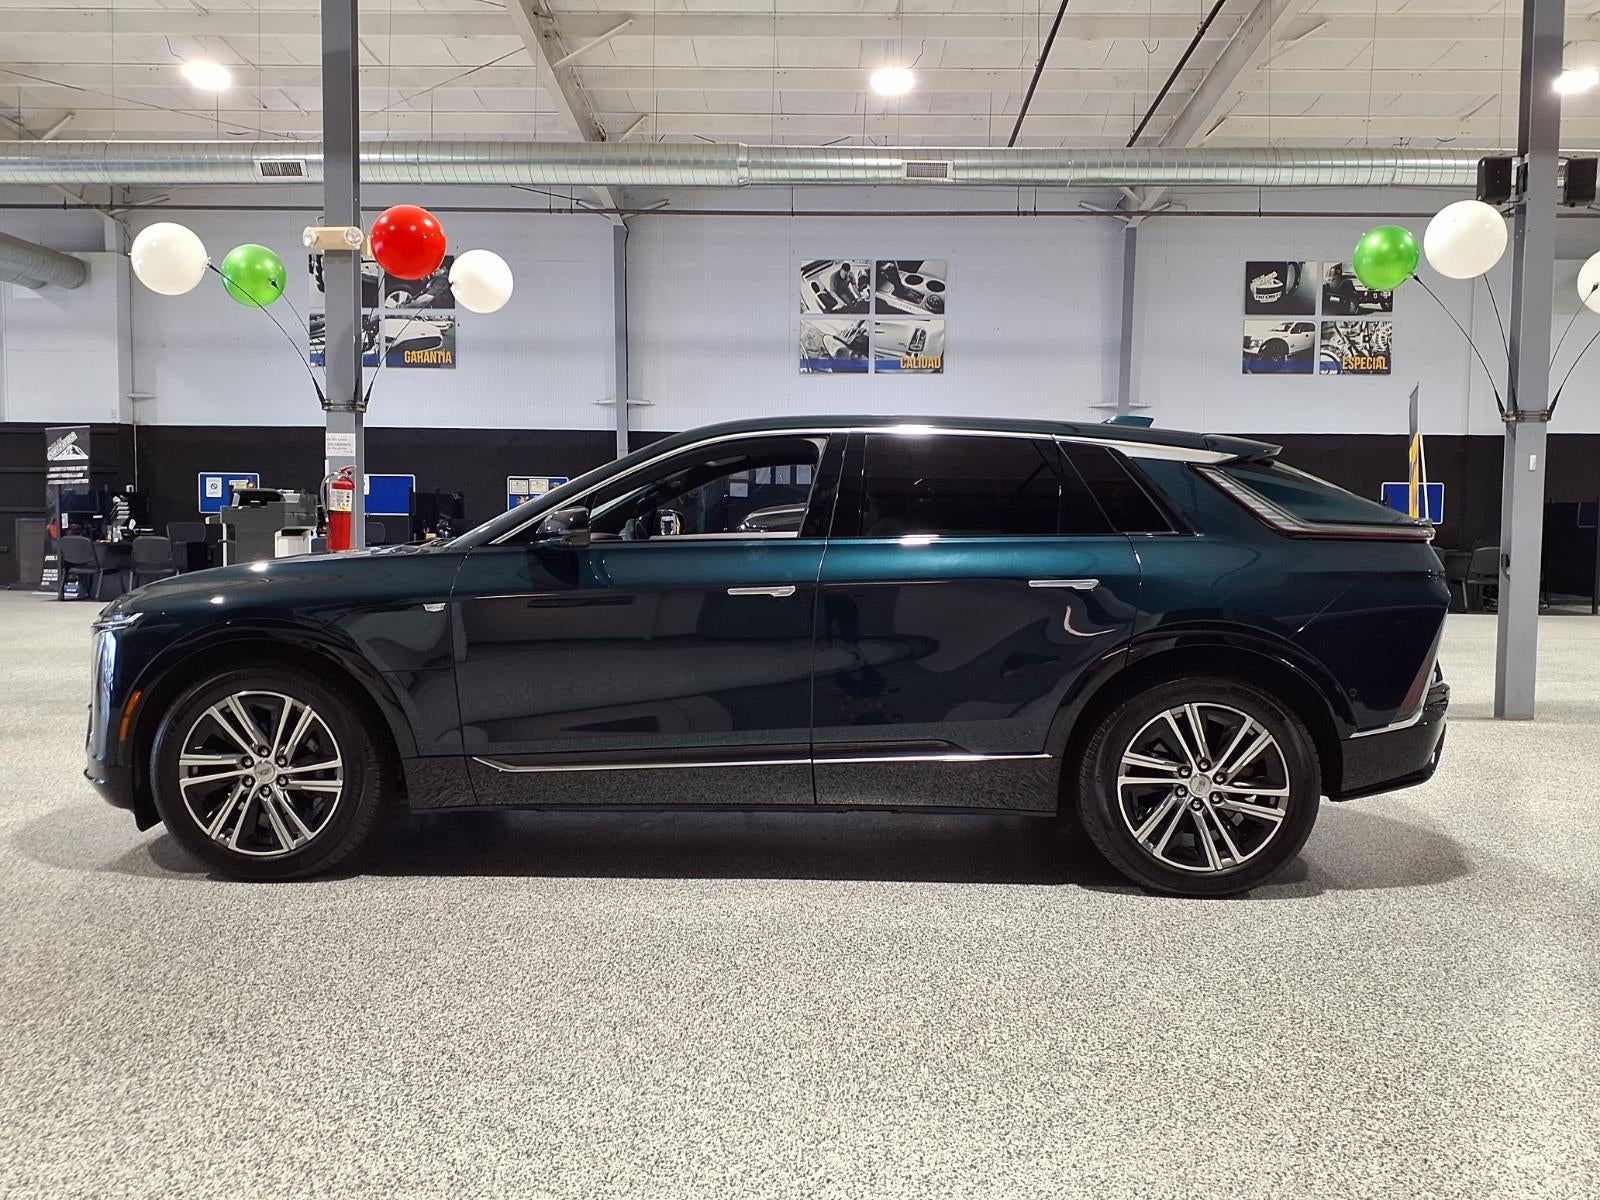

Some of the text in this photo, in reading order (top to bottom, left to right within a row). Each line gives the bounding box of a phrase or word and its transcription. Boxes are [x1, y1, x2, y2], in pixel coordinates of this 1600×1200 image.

[404, 349, 453, 364] GARANTÍA
[900, 354, 941, 369] CALIDAD
[1342, 355, 1389, 370] ESPECIAL
